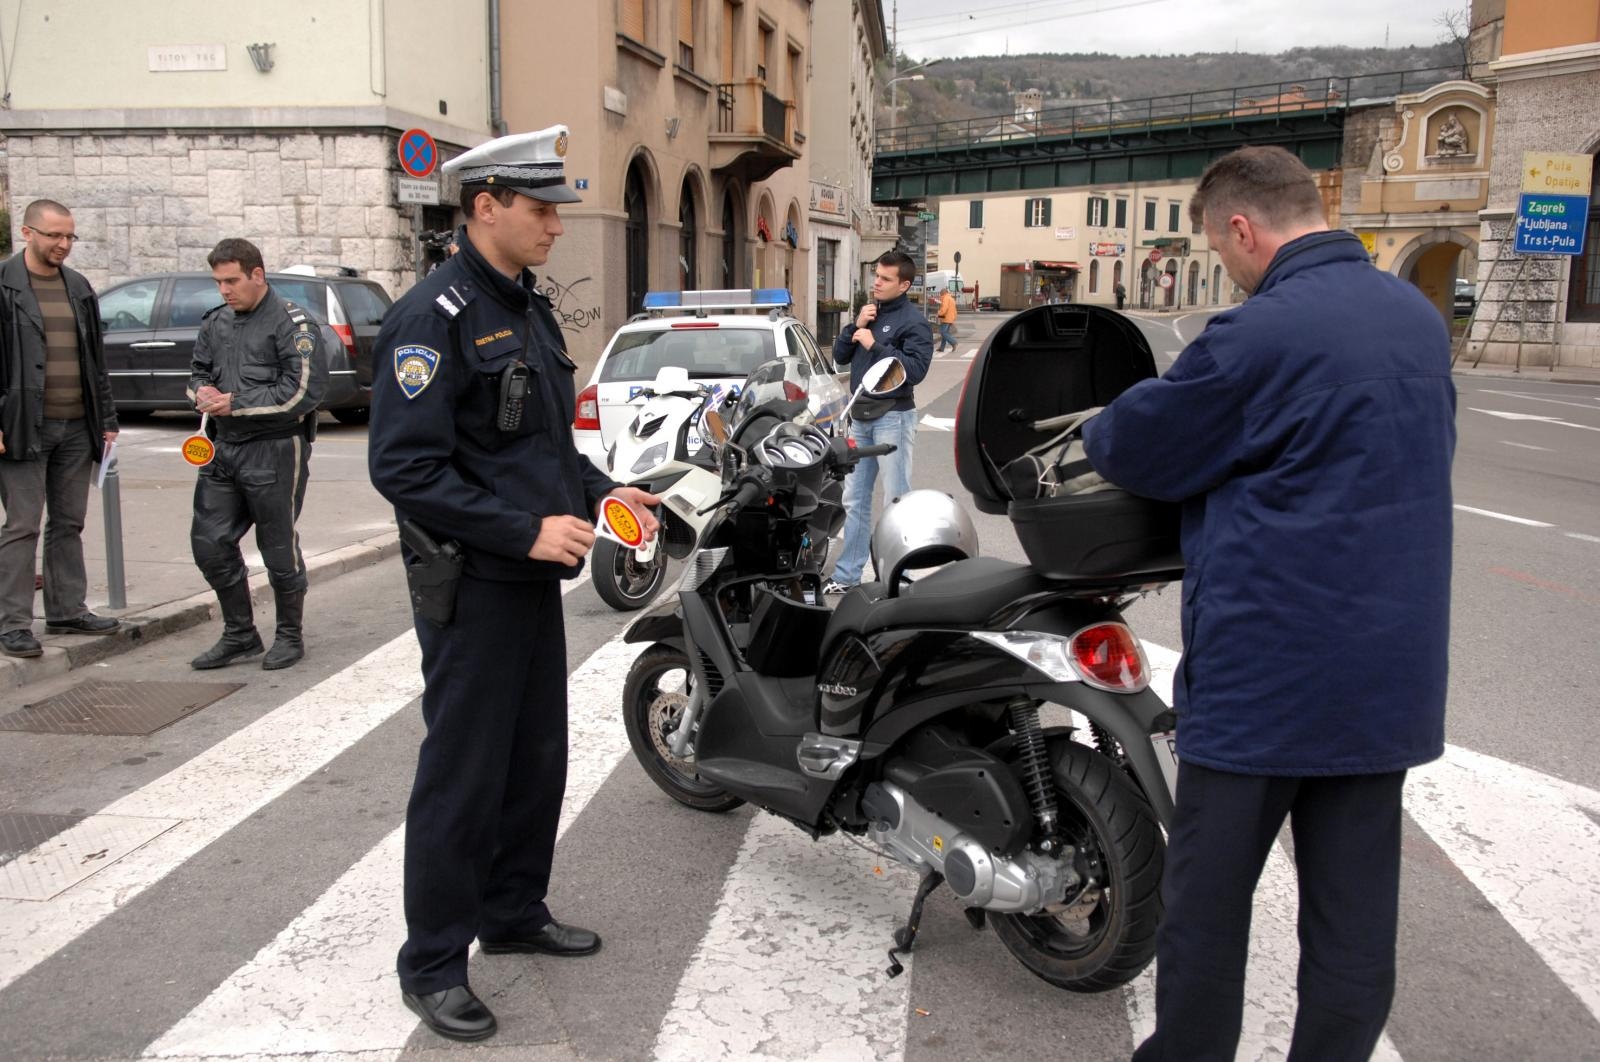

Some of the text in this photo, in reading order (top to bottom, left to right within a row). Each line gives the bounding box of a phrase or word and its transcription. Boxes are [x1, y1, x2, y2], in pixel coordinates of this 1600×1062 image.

[1546, 160, 1572, 171] Pula
[1545, 175, 1580, 188] Opatija
[1528, 201, 1566, 215] Zagreb
[1524, 218, 1568, 232] Ljubljana
[1523, 234, 1576, 247] Trst-Pula
[397, 347, 436, 363] POLICIJA
[187, 450, 208, 458] STOP
[612, 504, 638, 538] STOP
